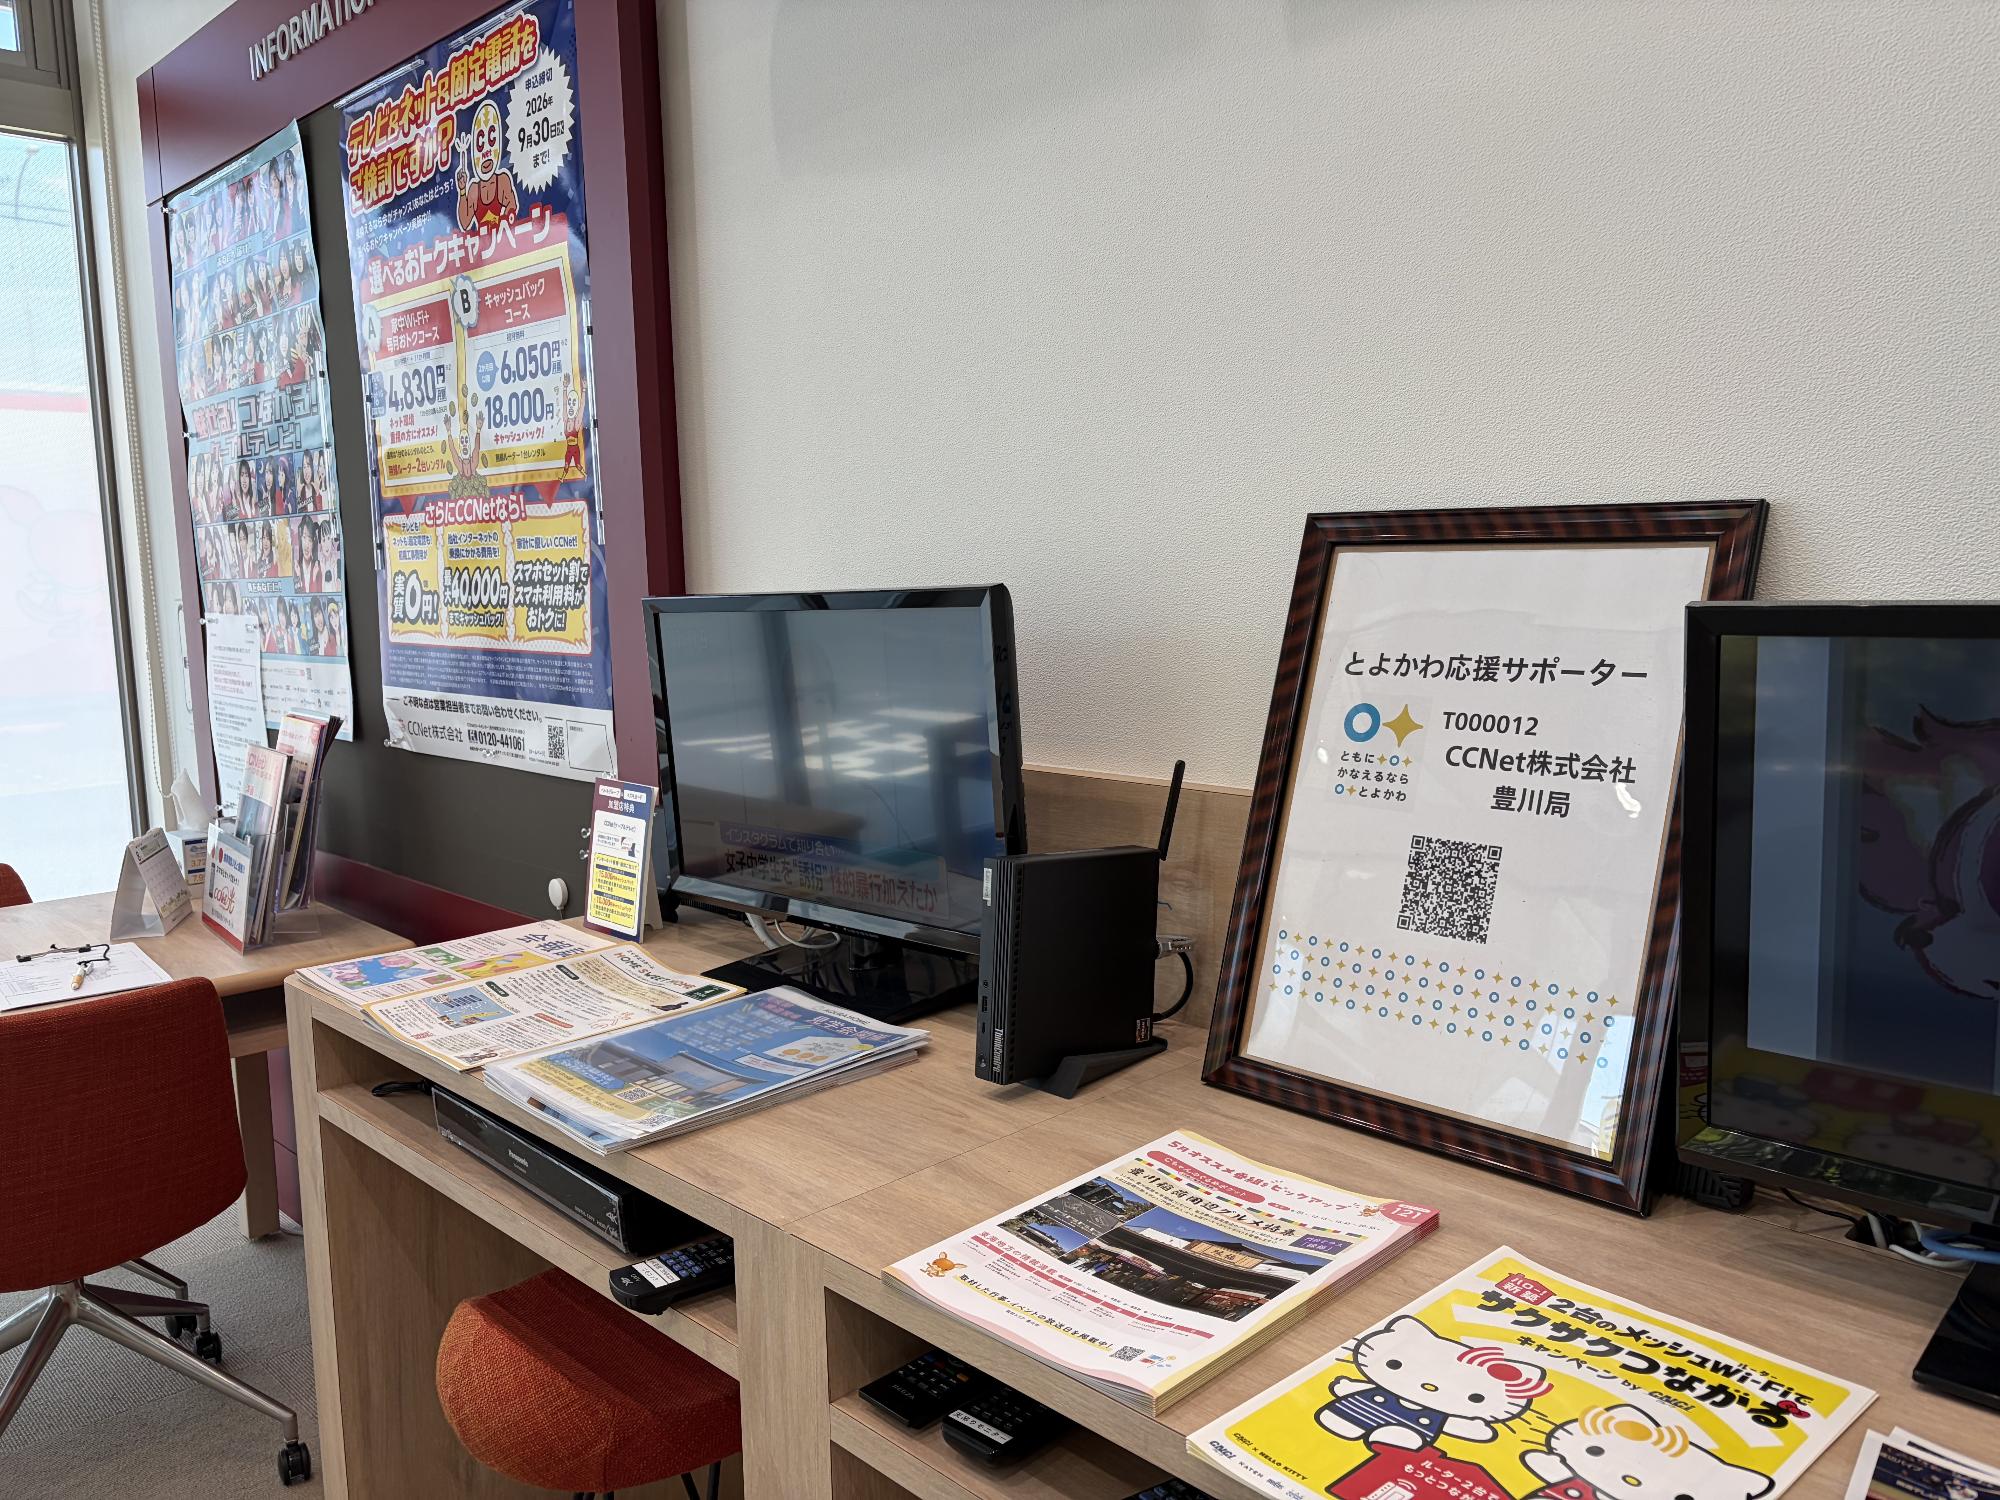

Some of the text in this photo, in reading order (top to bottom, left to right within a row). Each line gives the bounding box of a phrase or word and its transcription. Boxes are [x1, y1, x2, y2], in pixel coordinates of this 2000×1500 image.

[525, 68, 553, 91] 申込締切
[525, 92, 554, 118] 2026年
[351, 121, 452, 209] ご検討ですか?
[532, 152, 551, 169] まで!
[368, 203, 551, 290] 選べるおトクキャンペーン
[460, 288, 471, 314] B
[484, 277, 545, 309] キャッシュバック
[505, 304, 531, 324] コース
[367, 318, 376, 338] A
[386, 326, 440, 353] 毎月おトクコース
[500, 339, 561, 385] 6,050円
[388, 364, 446, 412] 4,830円
[485, 388, 554, 430] 18,000円
[493, 427, 545, 443] キャッシュバック!
[425, 495, 525, 524] さらにCCNetなら!
[554, 536, 578, 547] CCNet!
[514, 560, 588, 583] スマホセット割で
[515, 582, 584, 606] スマホ利用料が
[448, 611, 505, 627] までキャッシュバック!
[527, 609, 566, 630] おトクに!
[1344, 651, 1648, 687] とよかわ応援サポーター
[402, 695, 543, 723] ご不明な点は営業担当者までお問い合わせください。
[407, 720, 464, 743] CCNet株式会社
[1442, 711, 1539, 736] T000012
[478, 731, 526, 751] 0120-441061
[1340, 750, 1375, 765] ともに
[1444, 745, 1638, 785] CCNet株式会社
[1336, 766, 1409, 785] かなえるなら
[1358, 785, 1408, 802] とよかわ
[1490, 785, 1572, 819] 豊川局
[607, 800, 635, 815] 加盟店特典
[831, 868, 938, 913] 性的暴行加えたか
[614, 952, 642, 970] HOME
[992, 1028, 1004, 1073] ThinkCentre
[1168, 1140, 1350, 1211] 5月オススメ番組をピックアップ
[1127, 1167, 1296, 1237] 豊川稲荷周辺グルメ特集
[1391, 1208, 1422, 1220] 121
[979, 1230, 1059, 1276] 東海地方の情報満載
[1500, 1281, 1542, 1304] 新築
[1509, 1274, 1547, 1297] ハロー!
[959, 1273, 1115, 1350] 取材した行事・イベントの放送日を掲載中!
[1476, 1290, 1788, 1429] サクサクつながる
[1515, 1335, 1618, 1382] キャンペーン
[1620, 1379, 1642, 1392] by
[1547, 1298, 1815, 1407] 2台のメッシュWi-Fiで
[1737, 1363, 1779, 1381] ルーター
[892, 1384, 915, 1400] REGZA
[1258, 1451, 1282, 1468] HELLO
[1282, 1466, 1309, 1481] KITTY
[1421, 1460, 1500, 1500] ルーター2台で
